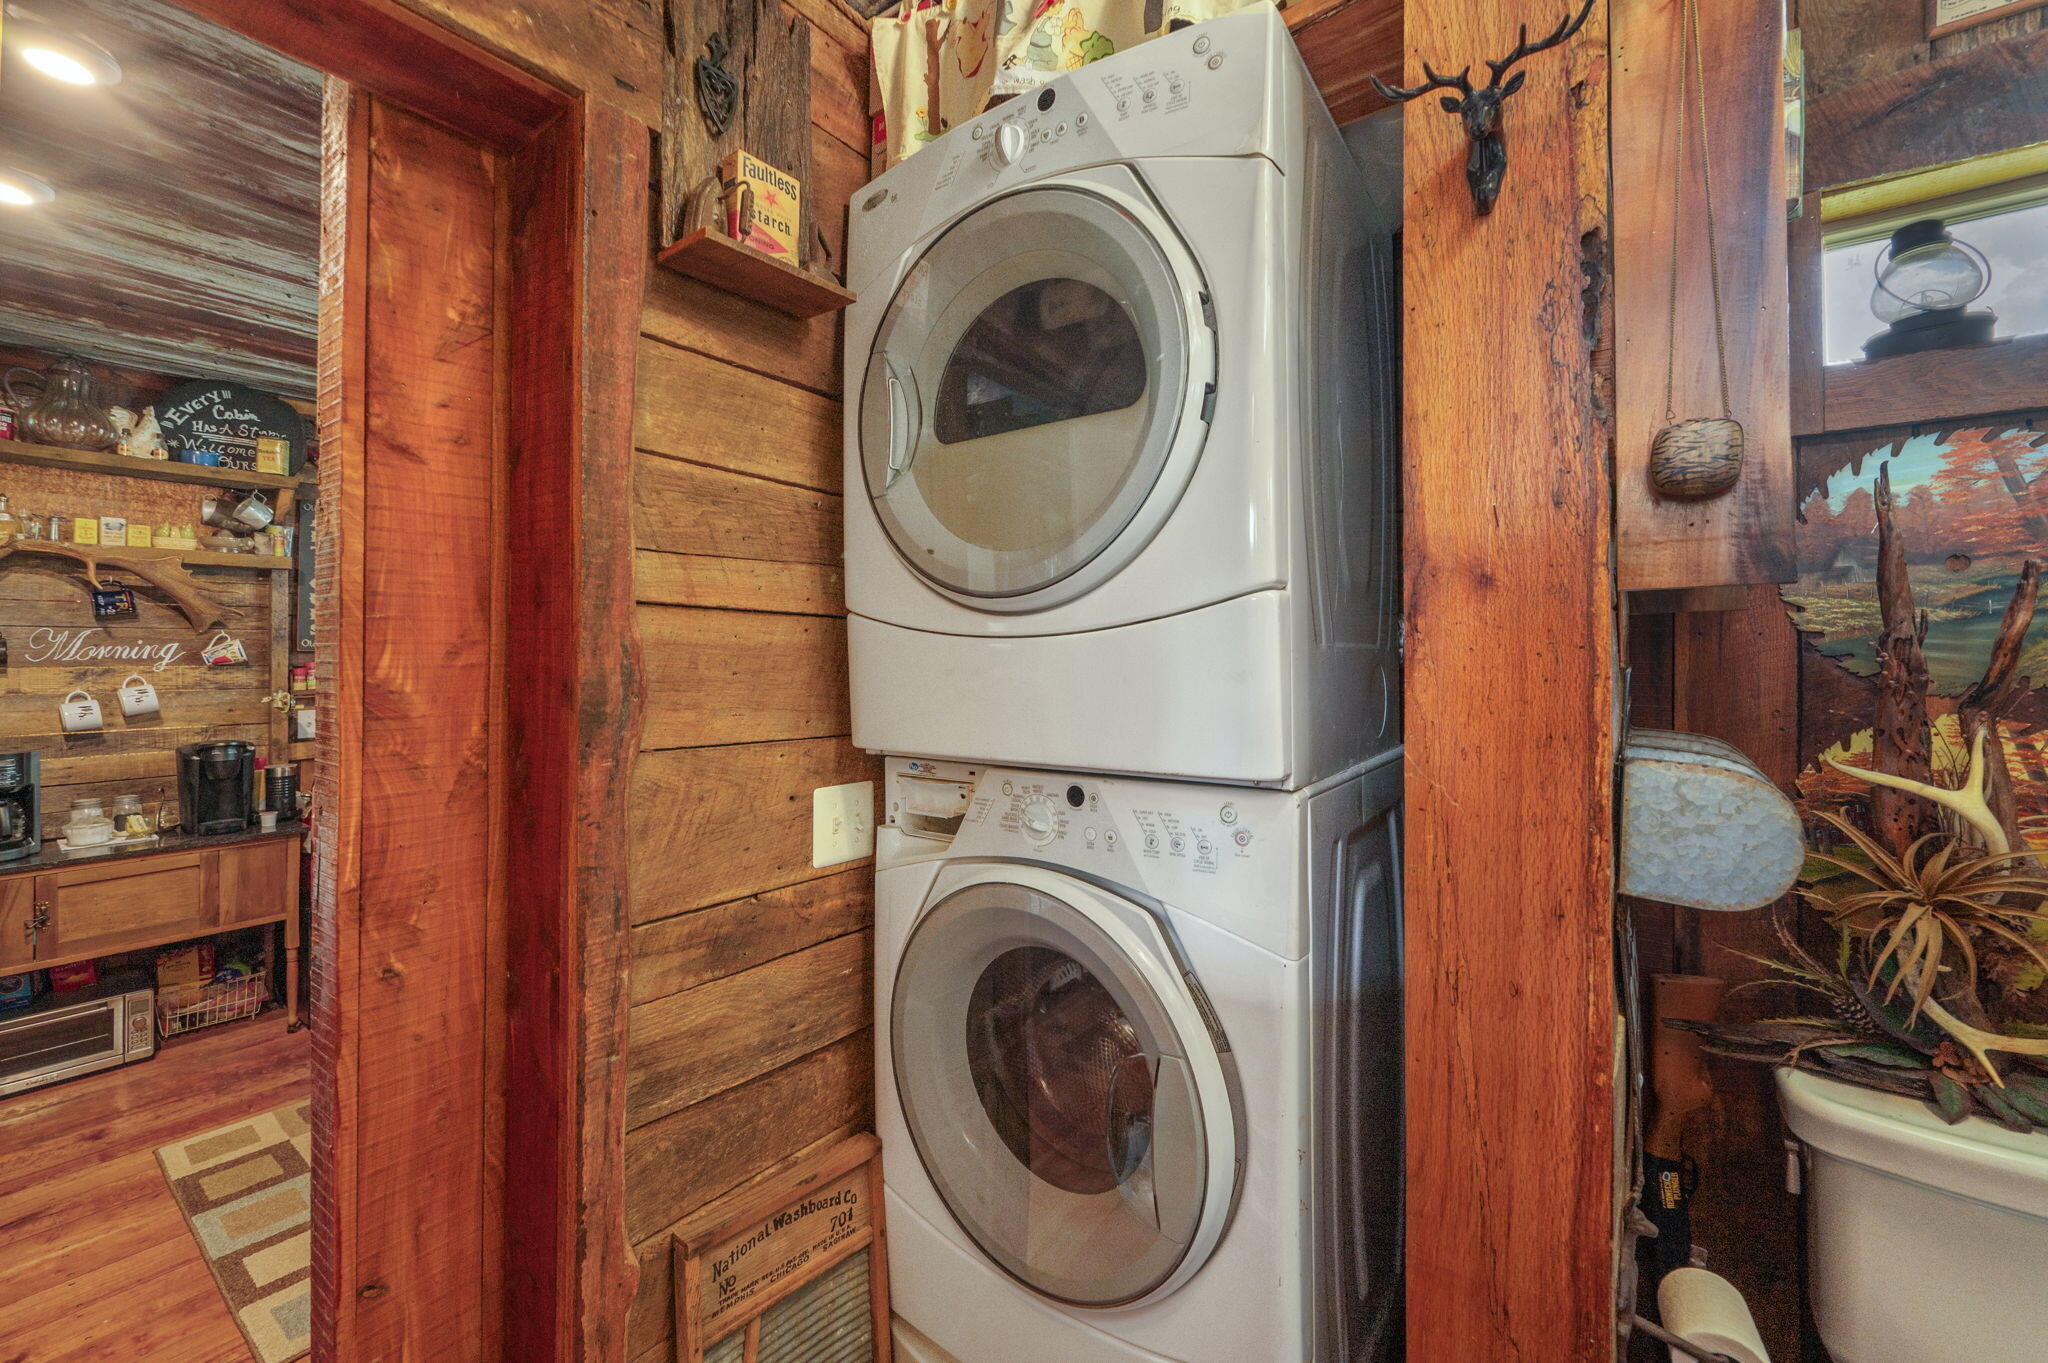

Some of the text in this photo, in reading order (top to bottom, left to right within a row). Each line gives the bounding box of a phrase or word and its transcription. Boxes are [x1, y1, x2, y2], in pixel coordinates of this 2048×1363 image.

[742, 155, 797, 201] Faultless
[212, 404, 261, 422] Cabin
[25, 627, 187, 672] Morning
[711, 1223, 772, 1283] National
[772, 1192, 842, 1231] Washboard
[830, 1207, 854, 1233] 701
[711, 1227, 857, 1319] MEMPHIS CHICAGO SAGINAW
